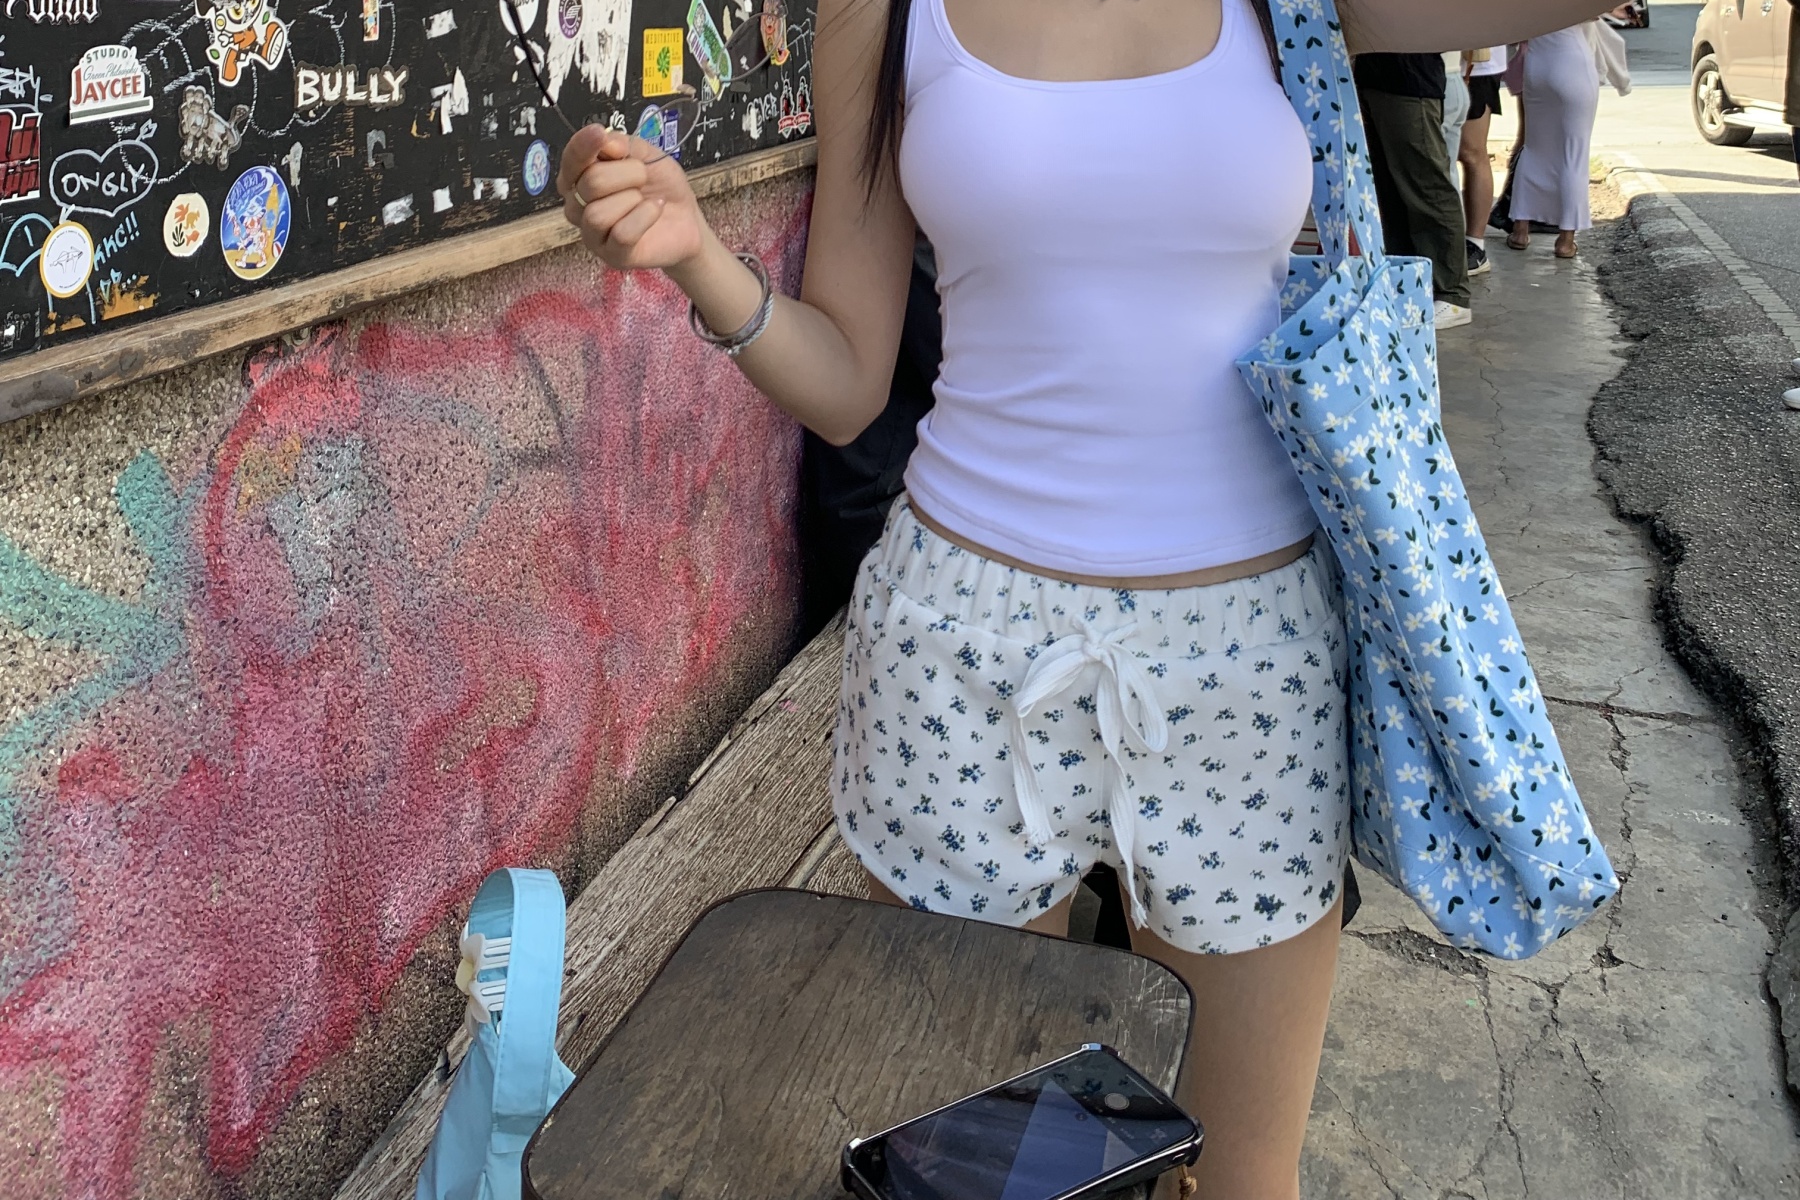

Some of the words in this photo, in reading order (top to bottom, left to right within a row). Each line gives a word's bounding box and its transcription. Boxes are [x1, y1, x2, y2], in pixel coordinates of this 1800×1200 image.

[87, 48, 128, 64] STUDIO
[83, 65, 106, 81] Green
[72, 68, 141, 105] JAYCEE
[297, 66, 407, 108] BULLY
